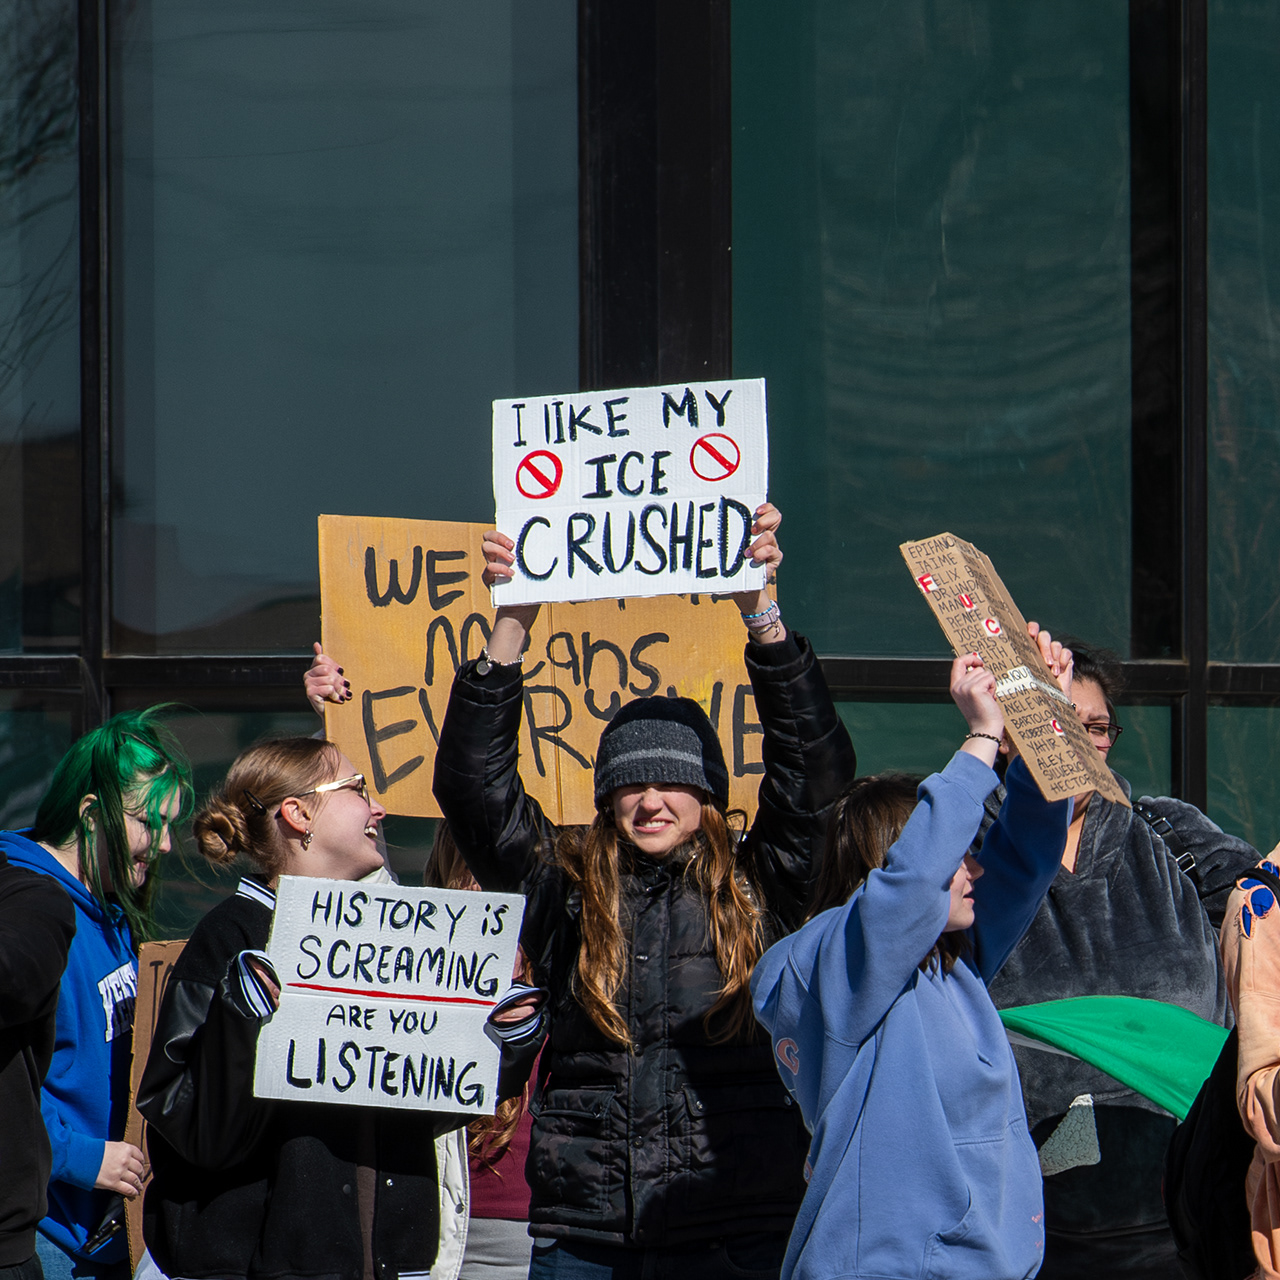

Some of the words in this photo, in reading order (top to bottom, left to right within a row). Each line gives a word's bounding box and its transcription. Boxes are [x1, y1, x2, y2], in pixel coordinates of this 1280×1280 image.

[510, 403, 527, 446] I
[661, 387, 733, 428] MY
[582, 450, 672, 499] ICE
[516, 494, 751, 582] CRUSHED
[364, 544, 470, 611] WE
[311, 890, 467, 945] HISTORY
[297, 934, 499, 997] SCREAMING
[326, 1004, 378, 1031] ARE
[389, 1008, 438, 1035] YOU
[286, 1037, 485, 1108] LISTENING
